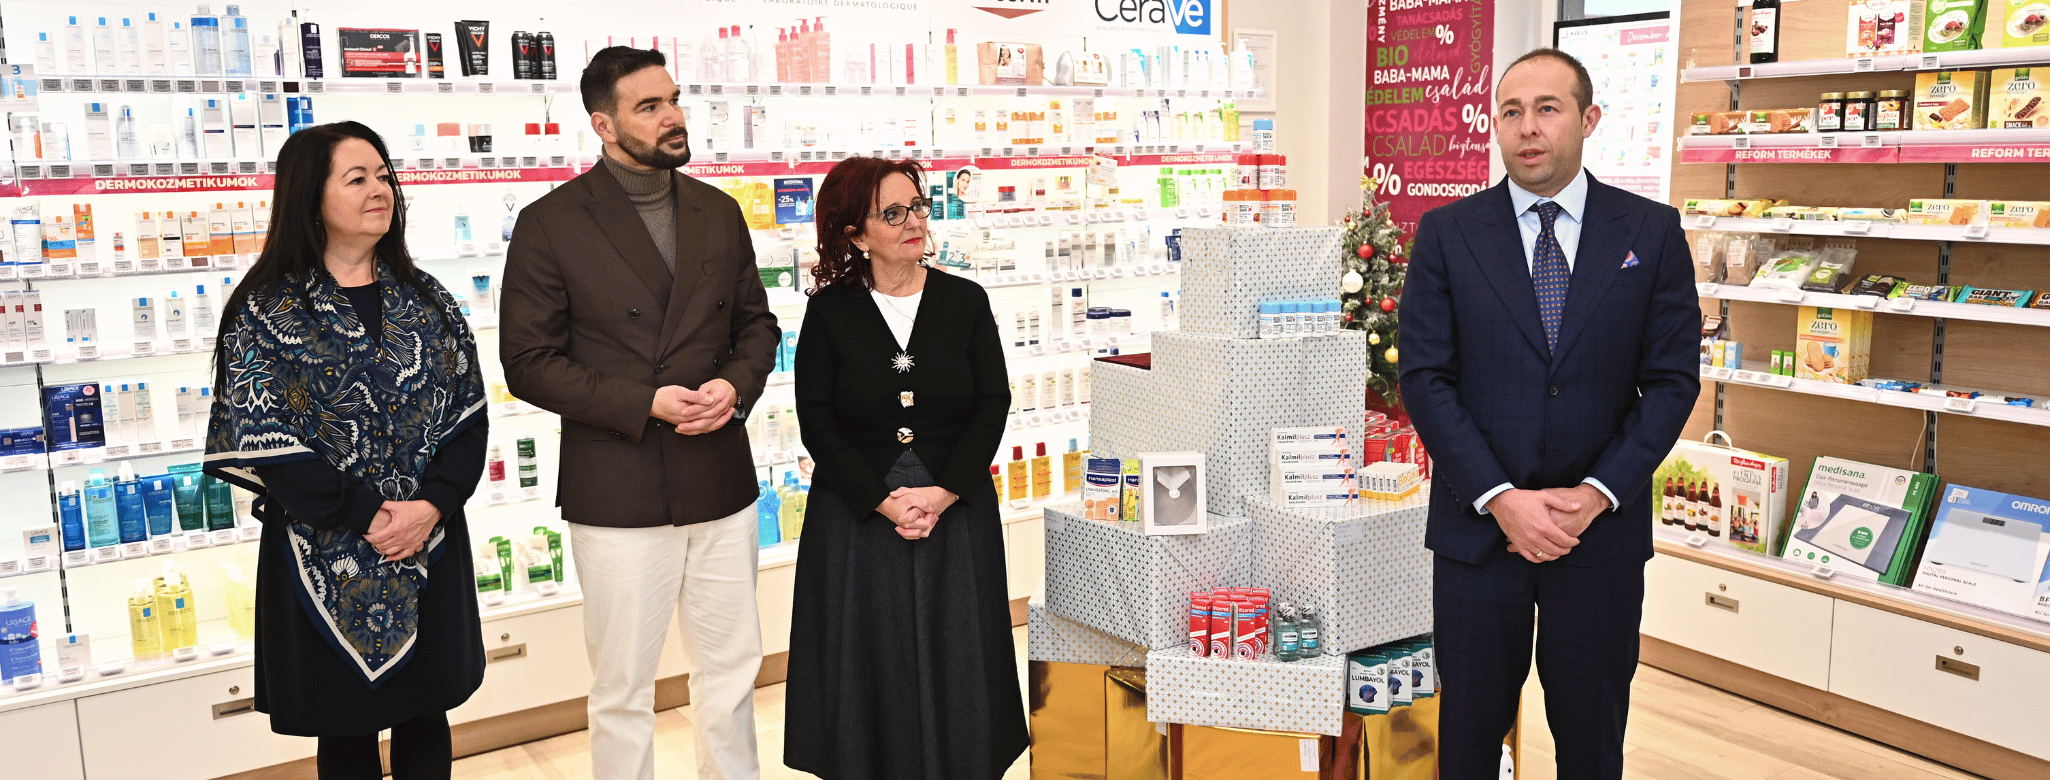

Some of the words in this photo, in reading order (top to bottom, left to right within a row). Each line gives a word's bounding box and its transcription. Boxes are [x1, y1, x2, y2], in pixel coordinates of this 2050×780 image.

[1435, 24, 1454, 45] %
[1377, 45, 1409, 67] BIO
[12, 65, 21, 75] 3
[1374, 65, 1450, 84] BABA-MAMA
[1425, 64, 1489, 103] család
[2007, 82, 2036, 91] zero
[1930, 85, 1956, 94] zero
[1462, 103, 1489, 133] %
[1373, 130, 1447, 157] CSALÁD
[1161, 153, 1233, 164] DERMOKOZMETIKUMOK
[1735, 150, 1776, 159] REFORM
[1777, 148, 1831, 159] TERMÉKEK
[1971, 148, 2024, 158] REFORM
[1404, 156, 1489, 180] EGÉSZSÉG
[95, 177, 257, 191] DERMOKOZMETIKUMOK
[1373, 162, 1402, 196] %
[2009, 206, 2034, 214] zero
[1907, 284, 1931, 294] ZERO
[1971, 289, 2013, 297] GIANT
[1811, 320, 1838, 331] zero
[1733, 470, 1762, 480] FITNESS
[1818, 464, 1866, 479] medisana
[1732, 476, 1762, 486] PROGRAM
[1940, 575, 1962, 584] PERSONAL
[6, 616, 32, 626] URIAGE
[1352, 674, 1385, 684] LUMBAYOL
